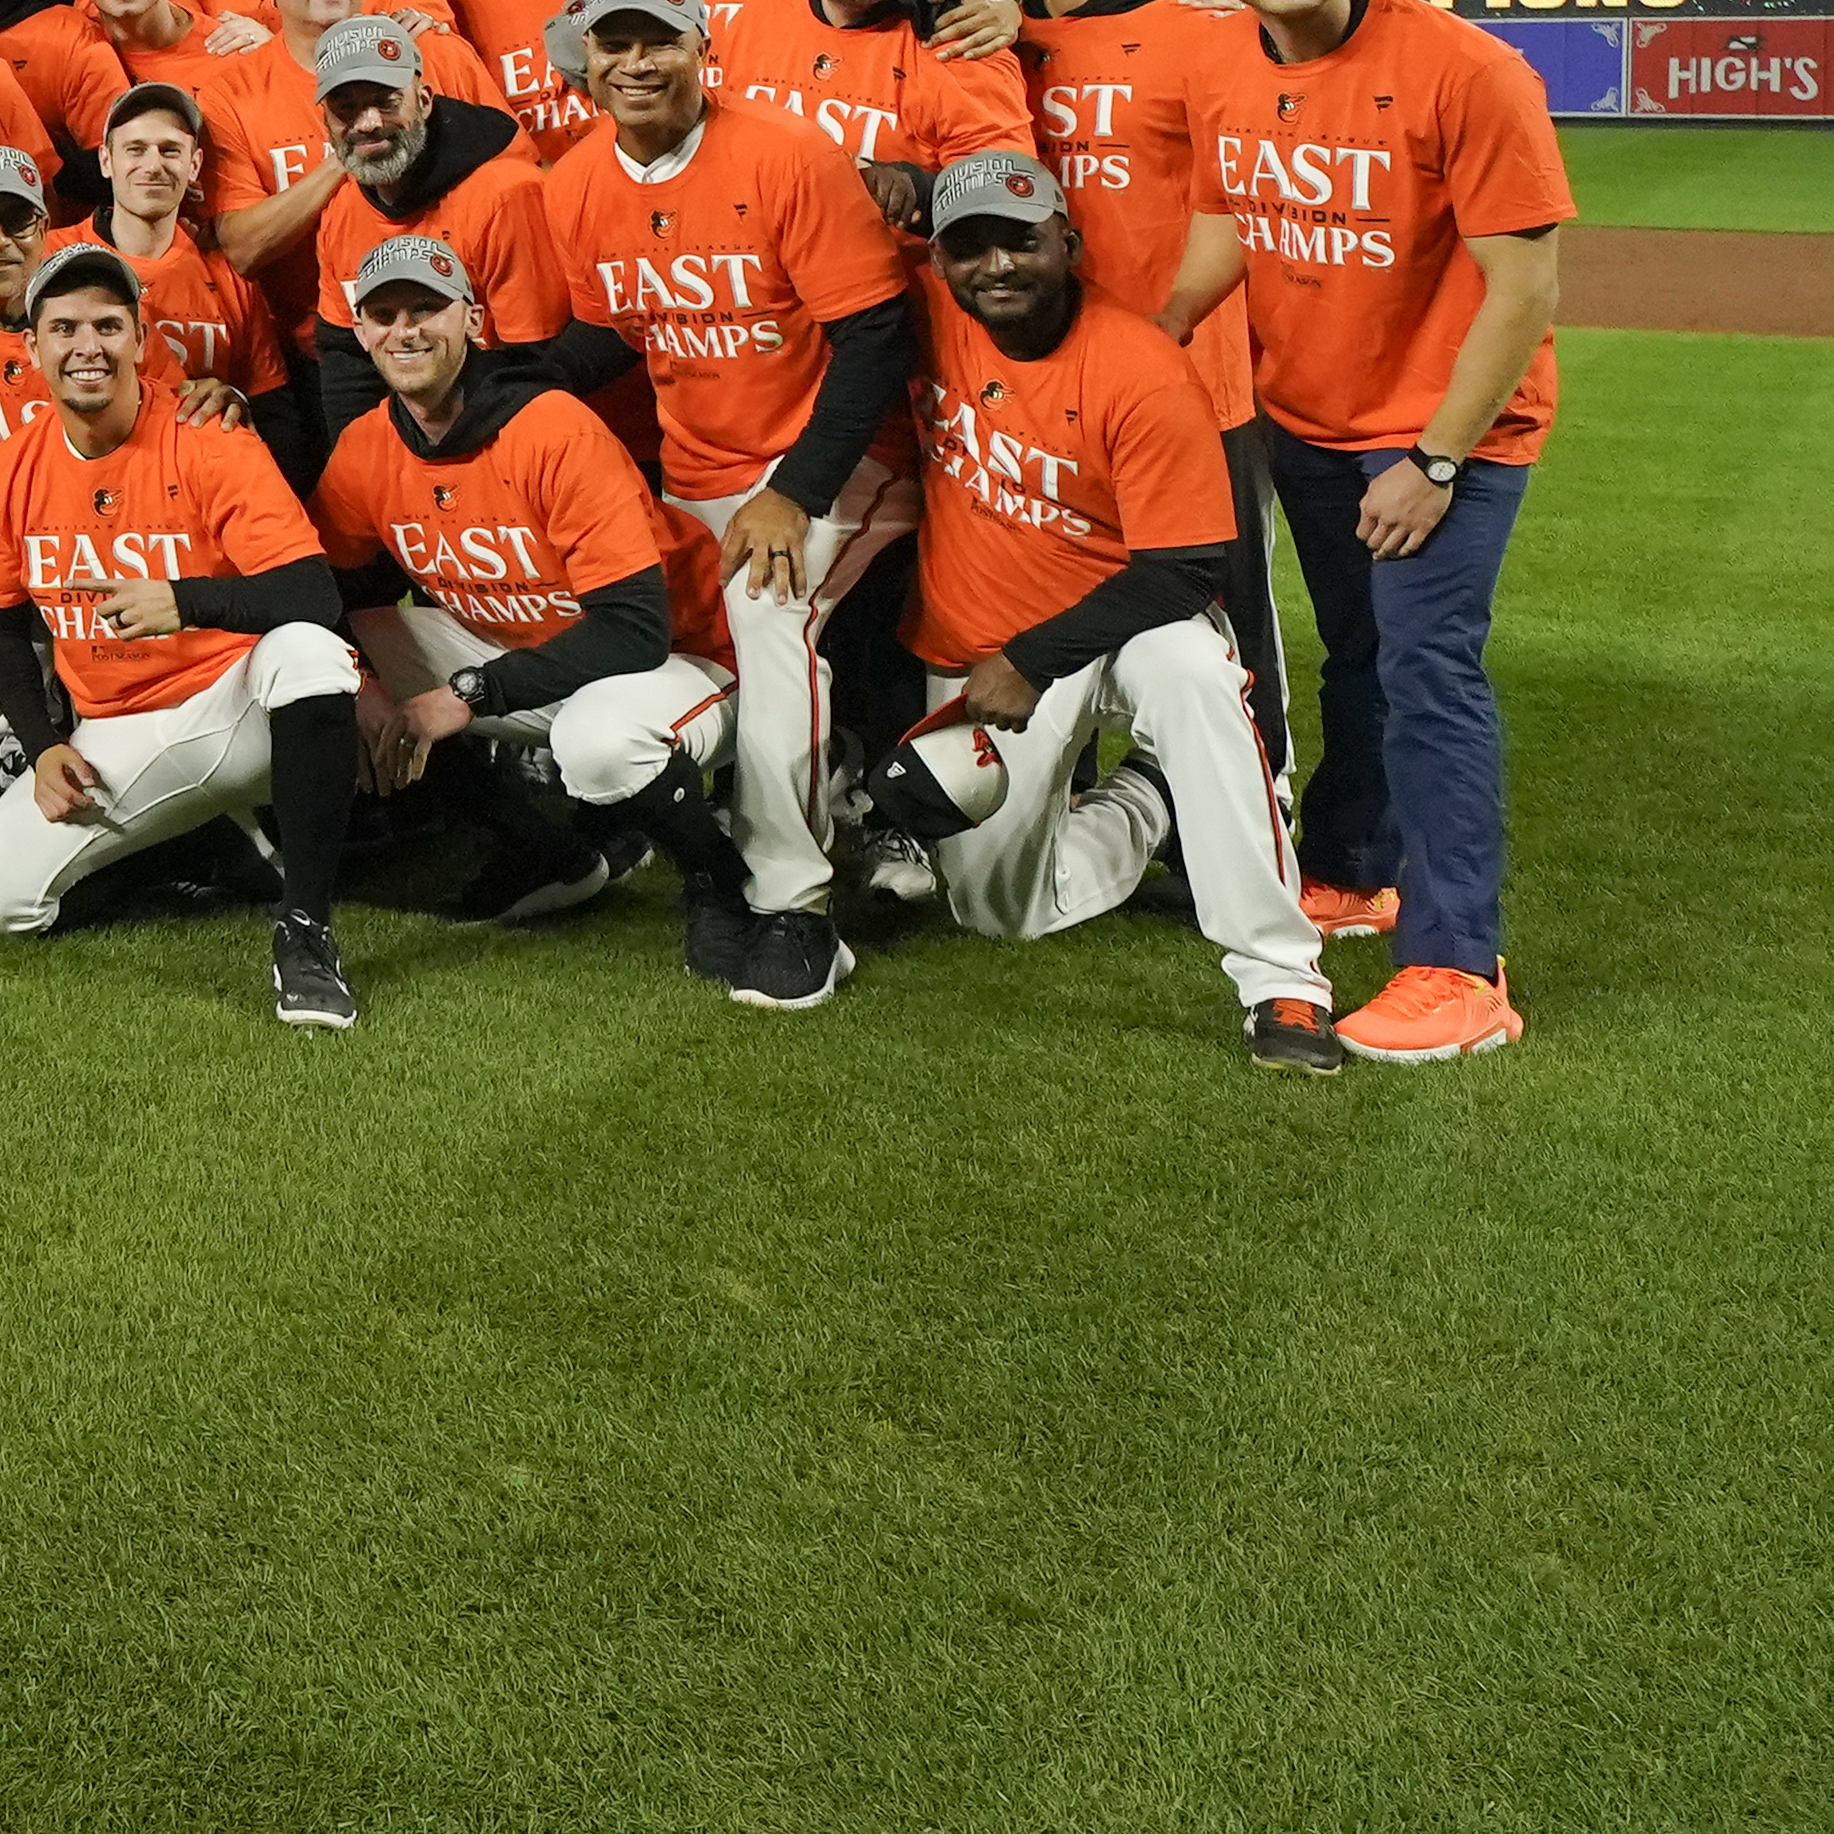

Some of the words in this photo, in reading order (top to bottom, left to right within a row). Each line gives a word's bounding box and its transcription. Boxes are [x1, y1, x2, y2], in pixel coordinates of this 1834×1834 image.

[1667, 56, 1819, 102] HIGH'S
[515, 94, 604, 133] CHA
[1042, 84, 1133, 137] ST
[1217, 135, 1391, 212] EAST
[1248, 201, 1346, 224] DIVISION
[1234, 212, 1396, 268] CHAMPS
[596, 253, 763, 315] EAST
[155, 319, 229, 370] ST
[24, 530, 192, 590] EAST
[389, 522, 541, 581] EAST
[60, 590, 116, 605] DIVI
[436, 577, 534, 594] DIVISION
